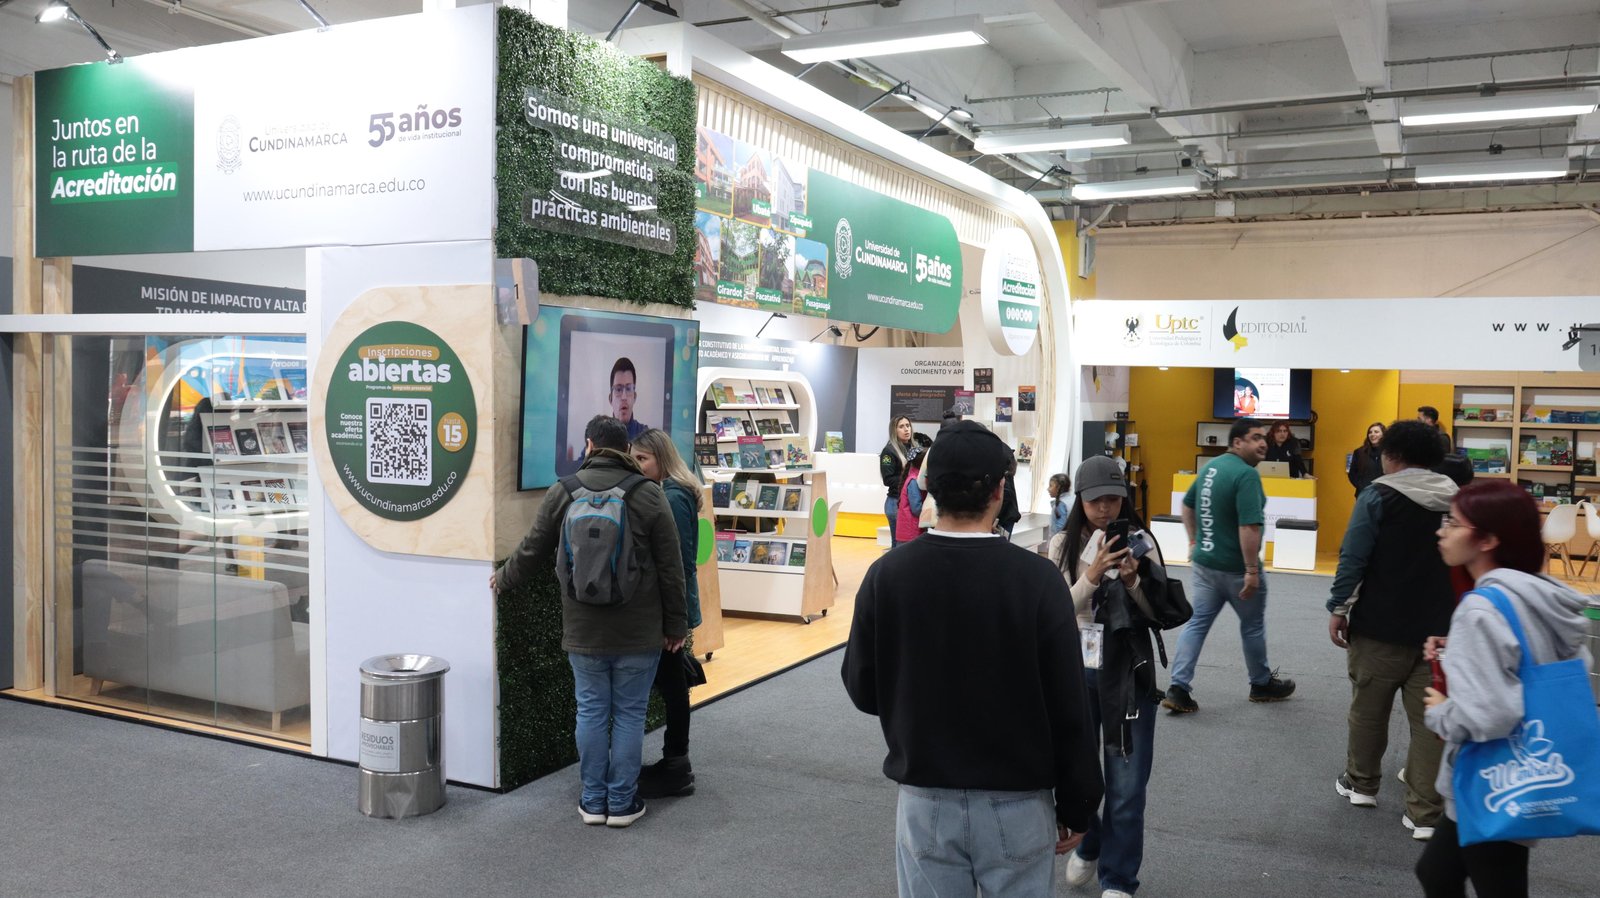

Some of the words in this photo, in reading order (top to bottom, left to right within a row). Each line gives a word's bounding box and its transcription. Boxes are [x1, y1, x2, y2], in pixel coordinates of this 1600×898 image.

[51, 118, 111, 141] Juntos
[115, 115, 139, 135] en
[368, 112, 395, 148] 55
[398, 104, 462, 132] años
[407, 133, 421, 141] vida
[422, 129, 462, 140] institucional
[528, 97, 579, 130] Somos
[582, 118, 608, 140] una
[611, 126, 675, 162] universidad
[52, 146, 66, 168] la
[72, 144, 107, 166] ruta
[112, 138, 136, 163] de
[141, 136, 156, 161] la
[249, 133, 348, 152] CUNDINAMARCA
[561, 142, 653, 182] comprometida
[51, 166, 176, 199] Acreditación
[243, 177, 426, 202] www.ucundinamarca.edu.co
[560, 172, 585, 193] con
[590, 177, 608, 198] las
[611, 180, 653, 206] buenas
[531, 196, 597, 226] prácticas
[601, 212, 671, 242] ambientales
[855, 246, 908, 274] CUNDINAMARCA
[864, 240, 894, 256] Universidad
[893, 248, 900, 258] de
[915, 253, 928, 283] 55
[927, 255, 952, 280] años
[140, 286, 189, 303] MISIÓN
[191, 291, 207, 304] DE
[210, 292, 262, 309] IMPACTO
[263, 298, 272, 309] Y
[273, 299, 300, 312] ALTA
[717, 285, 743, 298] Girardot
[1155, 314, 1199, 334] Uptc
[1240, 322, 1308, 333] EDITORIAL
[367, 347, 433, 359] Inscripciones
[702, 340, 732, 349] CONSTITUTIVO
[349, 355, 451, 383] abiertas
[443, 424, 462, 443] 15
[343, 463, 457, 513] www.ucundinamarca.edu.co
[1200, 467, 1217, 552] AREANDINA
